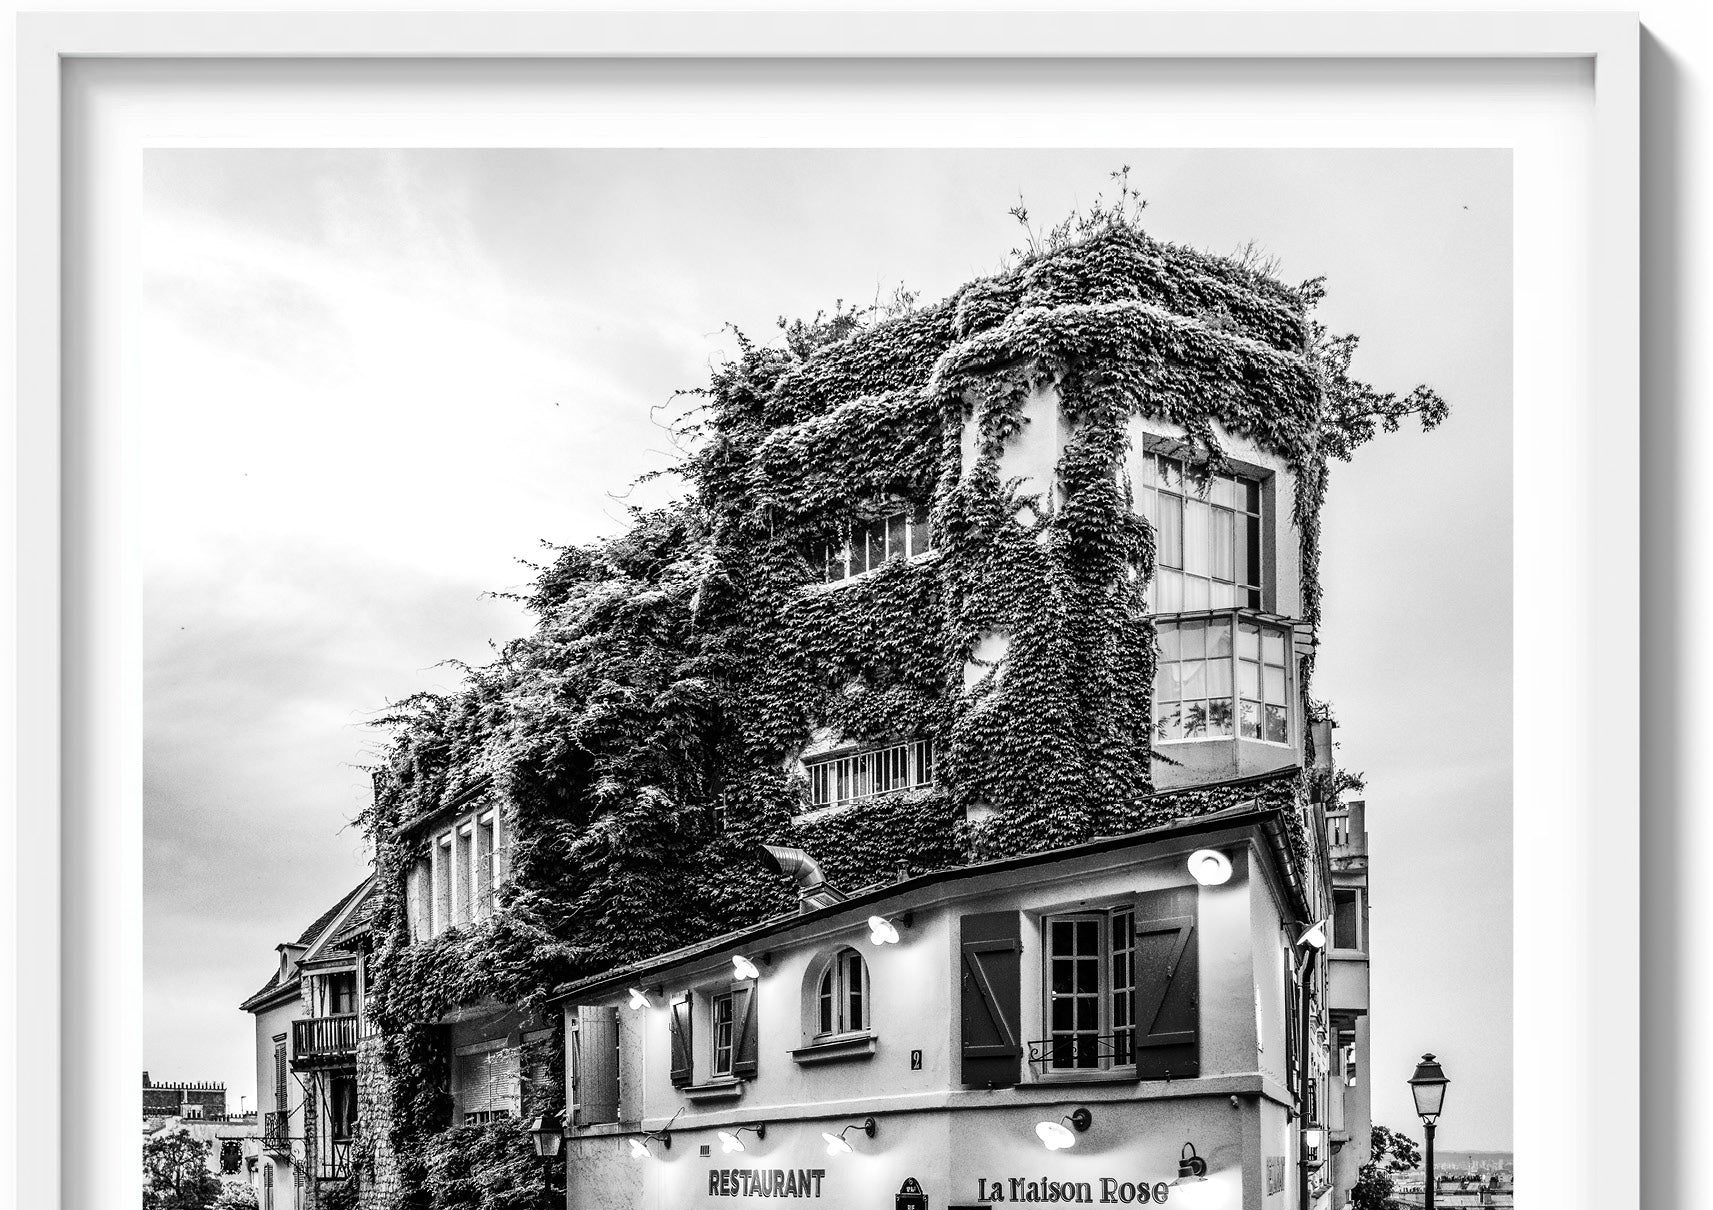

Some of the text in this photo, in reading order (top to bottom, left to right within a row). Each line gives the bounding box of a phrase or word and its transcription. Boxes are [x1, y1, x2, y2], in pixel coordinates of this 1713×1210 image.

[913, 1051, 920, 1069] 2
[708, 1168, 826, 1198] RESTAURANT
[977, 1176, 1170, 1204] La Maison Rose
